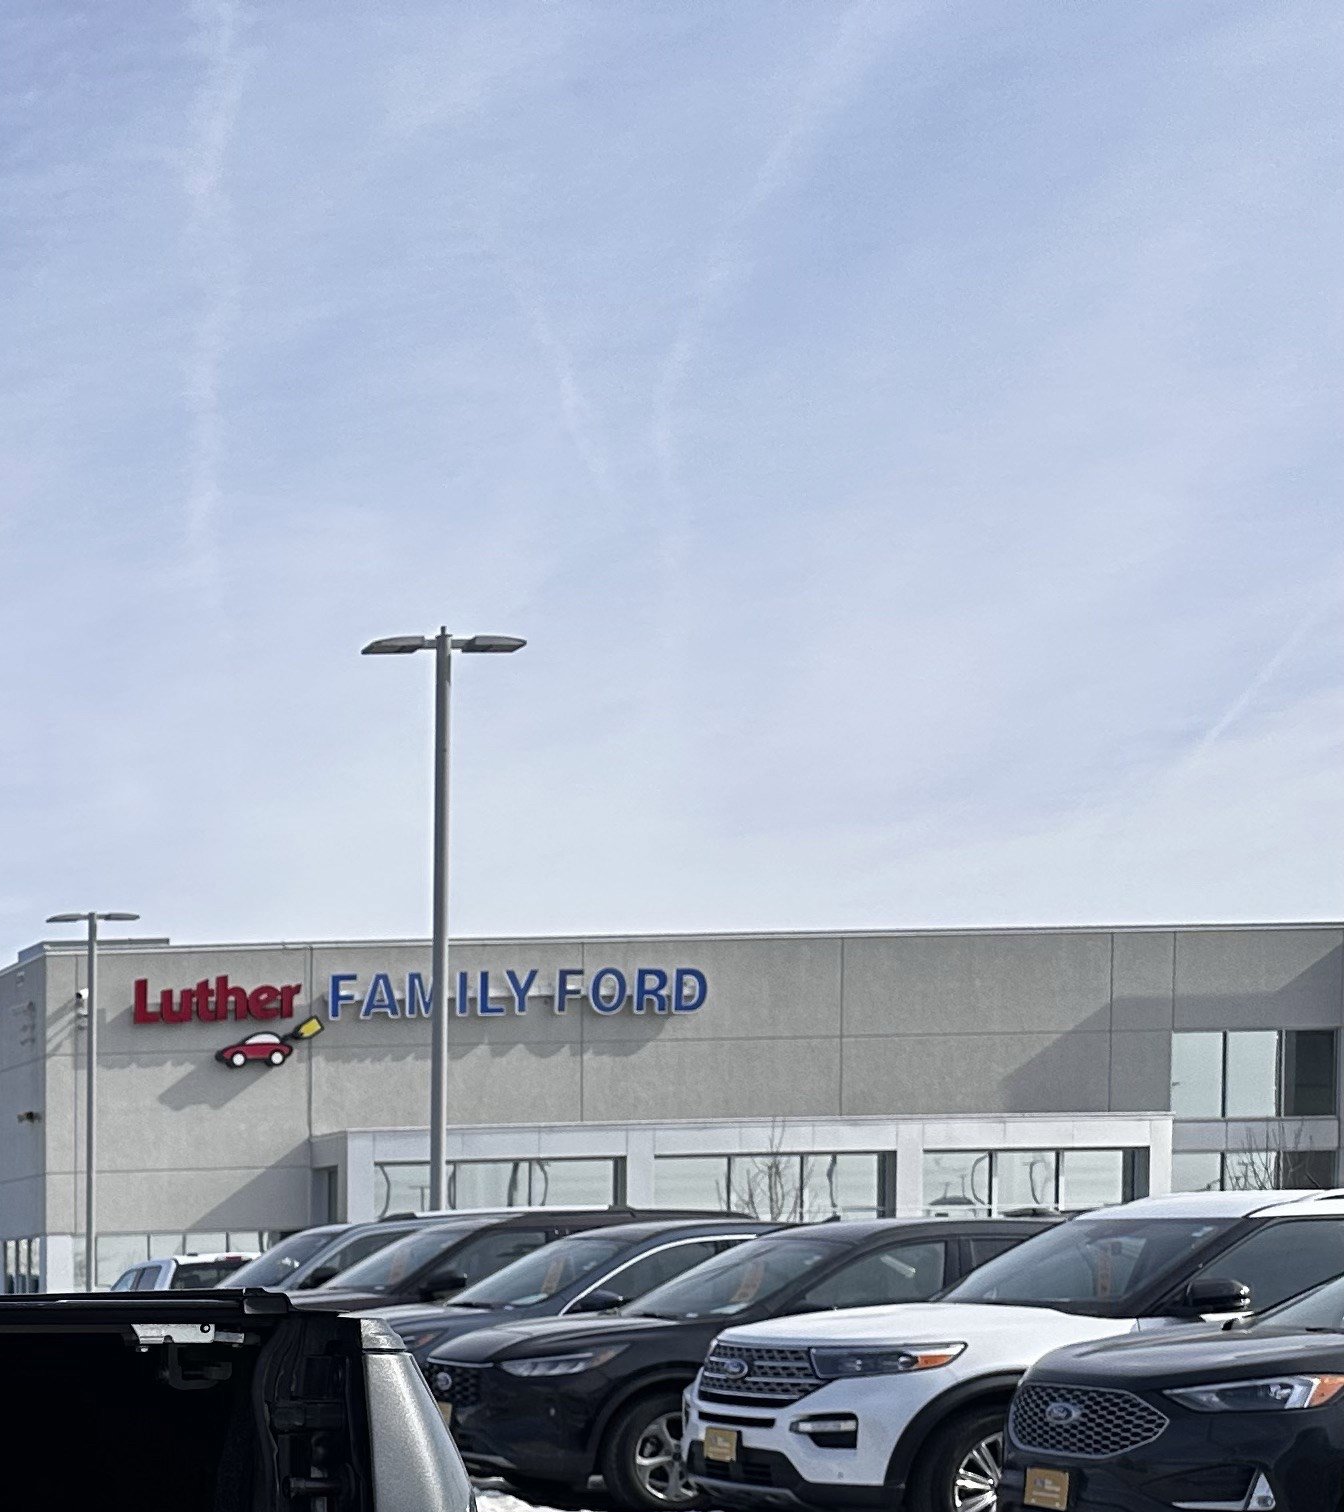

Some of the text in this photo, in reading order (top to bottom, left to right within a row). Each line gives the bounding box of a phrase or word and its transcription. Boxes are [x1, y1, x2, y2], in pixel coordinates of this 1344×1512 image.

[133, 968, 708, 1024] Luther FAMILY FORD
